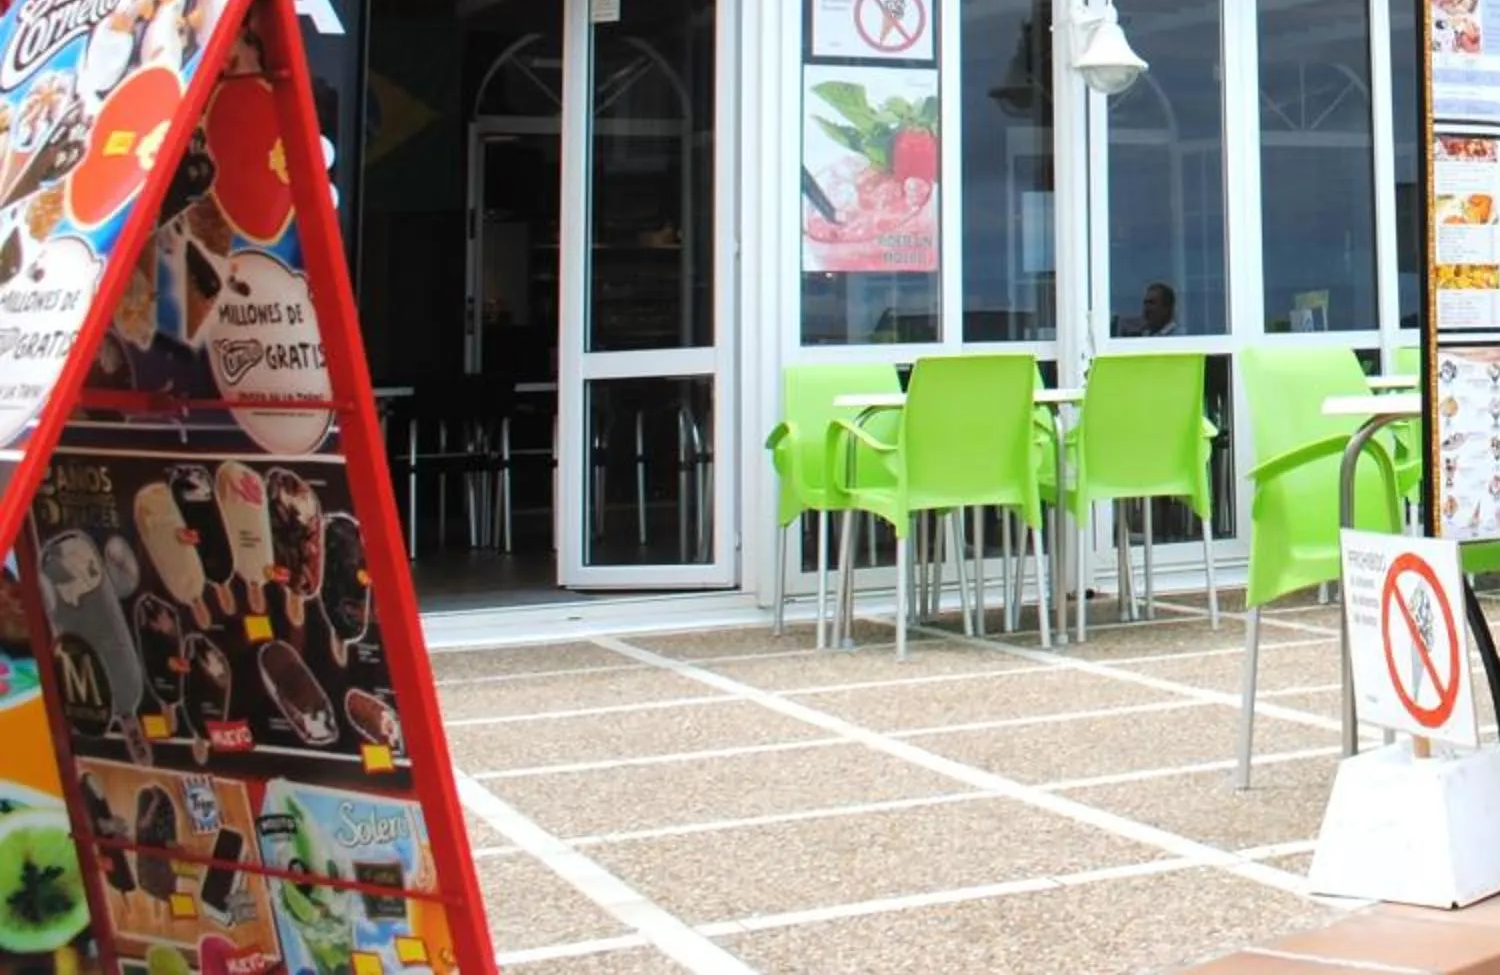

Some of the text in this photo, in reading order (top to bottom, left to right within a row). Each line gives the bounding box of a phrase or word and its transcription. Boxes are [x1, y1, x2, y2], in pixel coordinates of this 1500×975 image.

[219, 303, 304, 326] MILLONES DE
[265, 342, 328, 369] GRATIS
